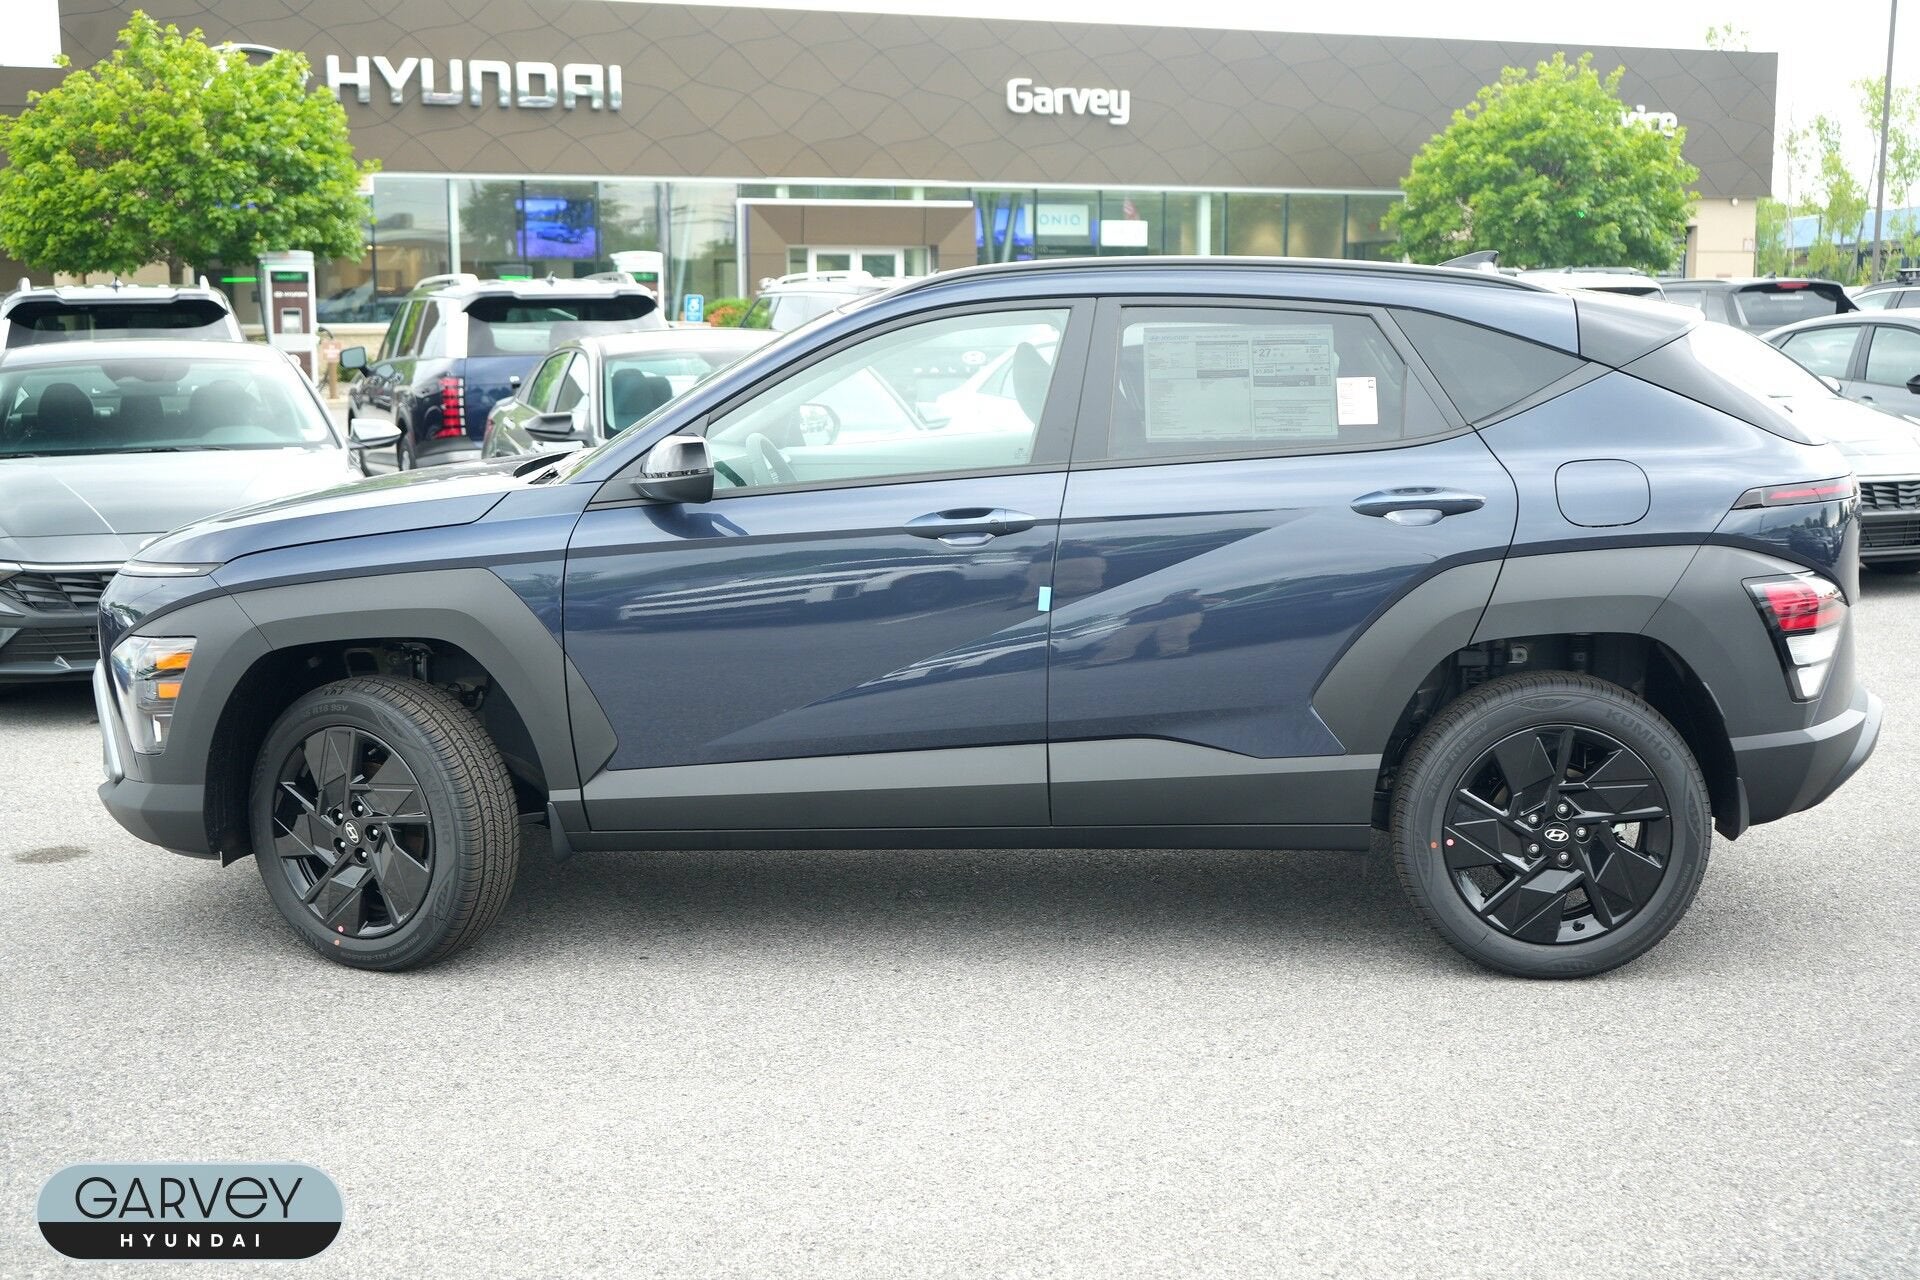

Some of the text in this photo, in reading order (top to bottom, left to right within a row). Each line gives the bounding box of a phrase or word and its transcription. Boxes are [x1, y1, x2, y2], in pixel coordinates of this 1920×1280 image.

[326, 54, 623, 111] HYUNDAI
[1006, 77, 1131, 125] Garvey
[1038, 213, 1081, 226] ONIQ
[1258, 348, 1272, 357] 27
[1605, 708, 1672, 761] KUMHO
